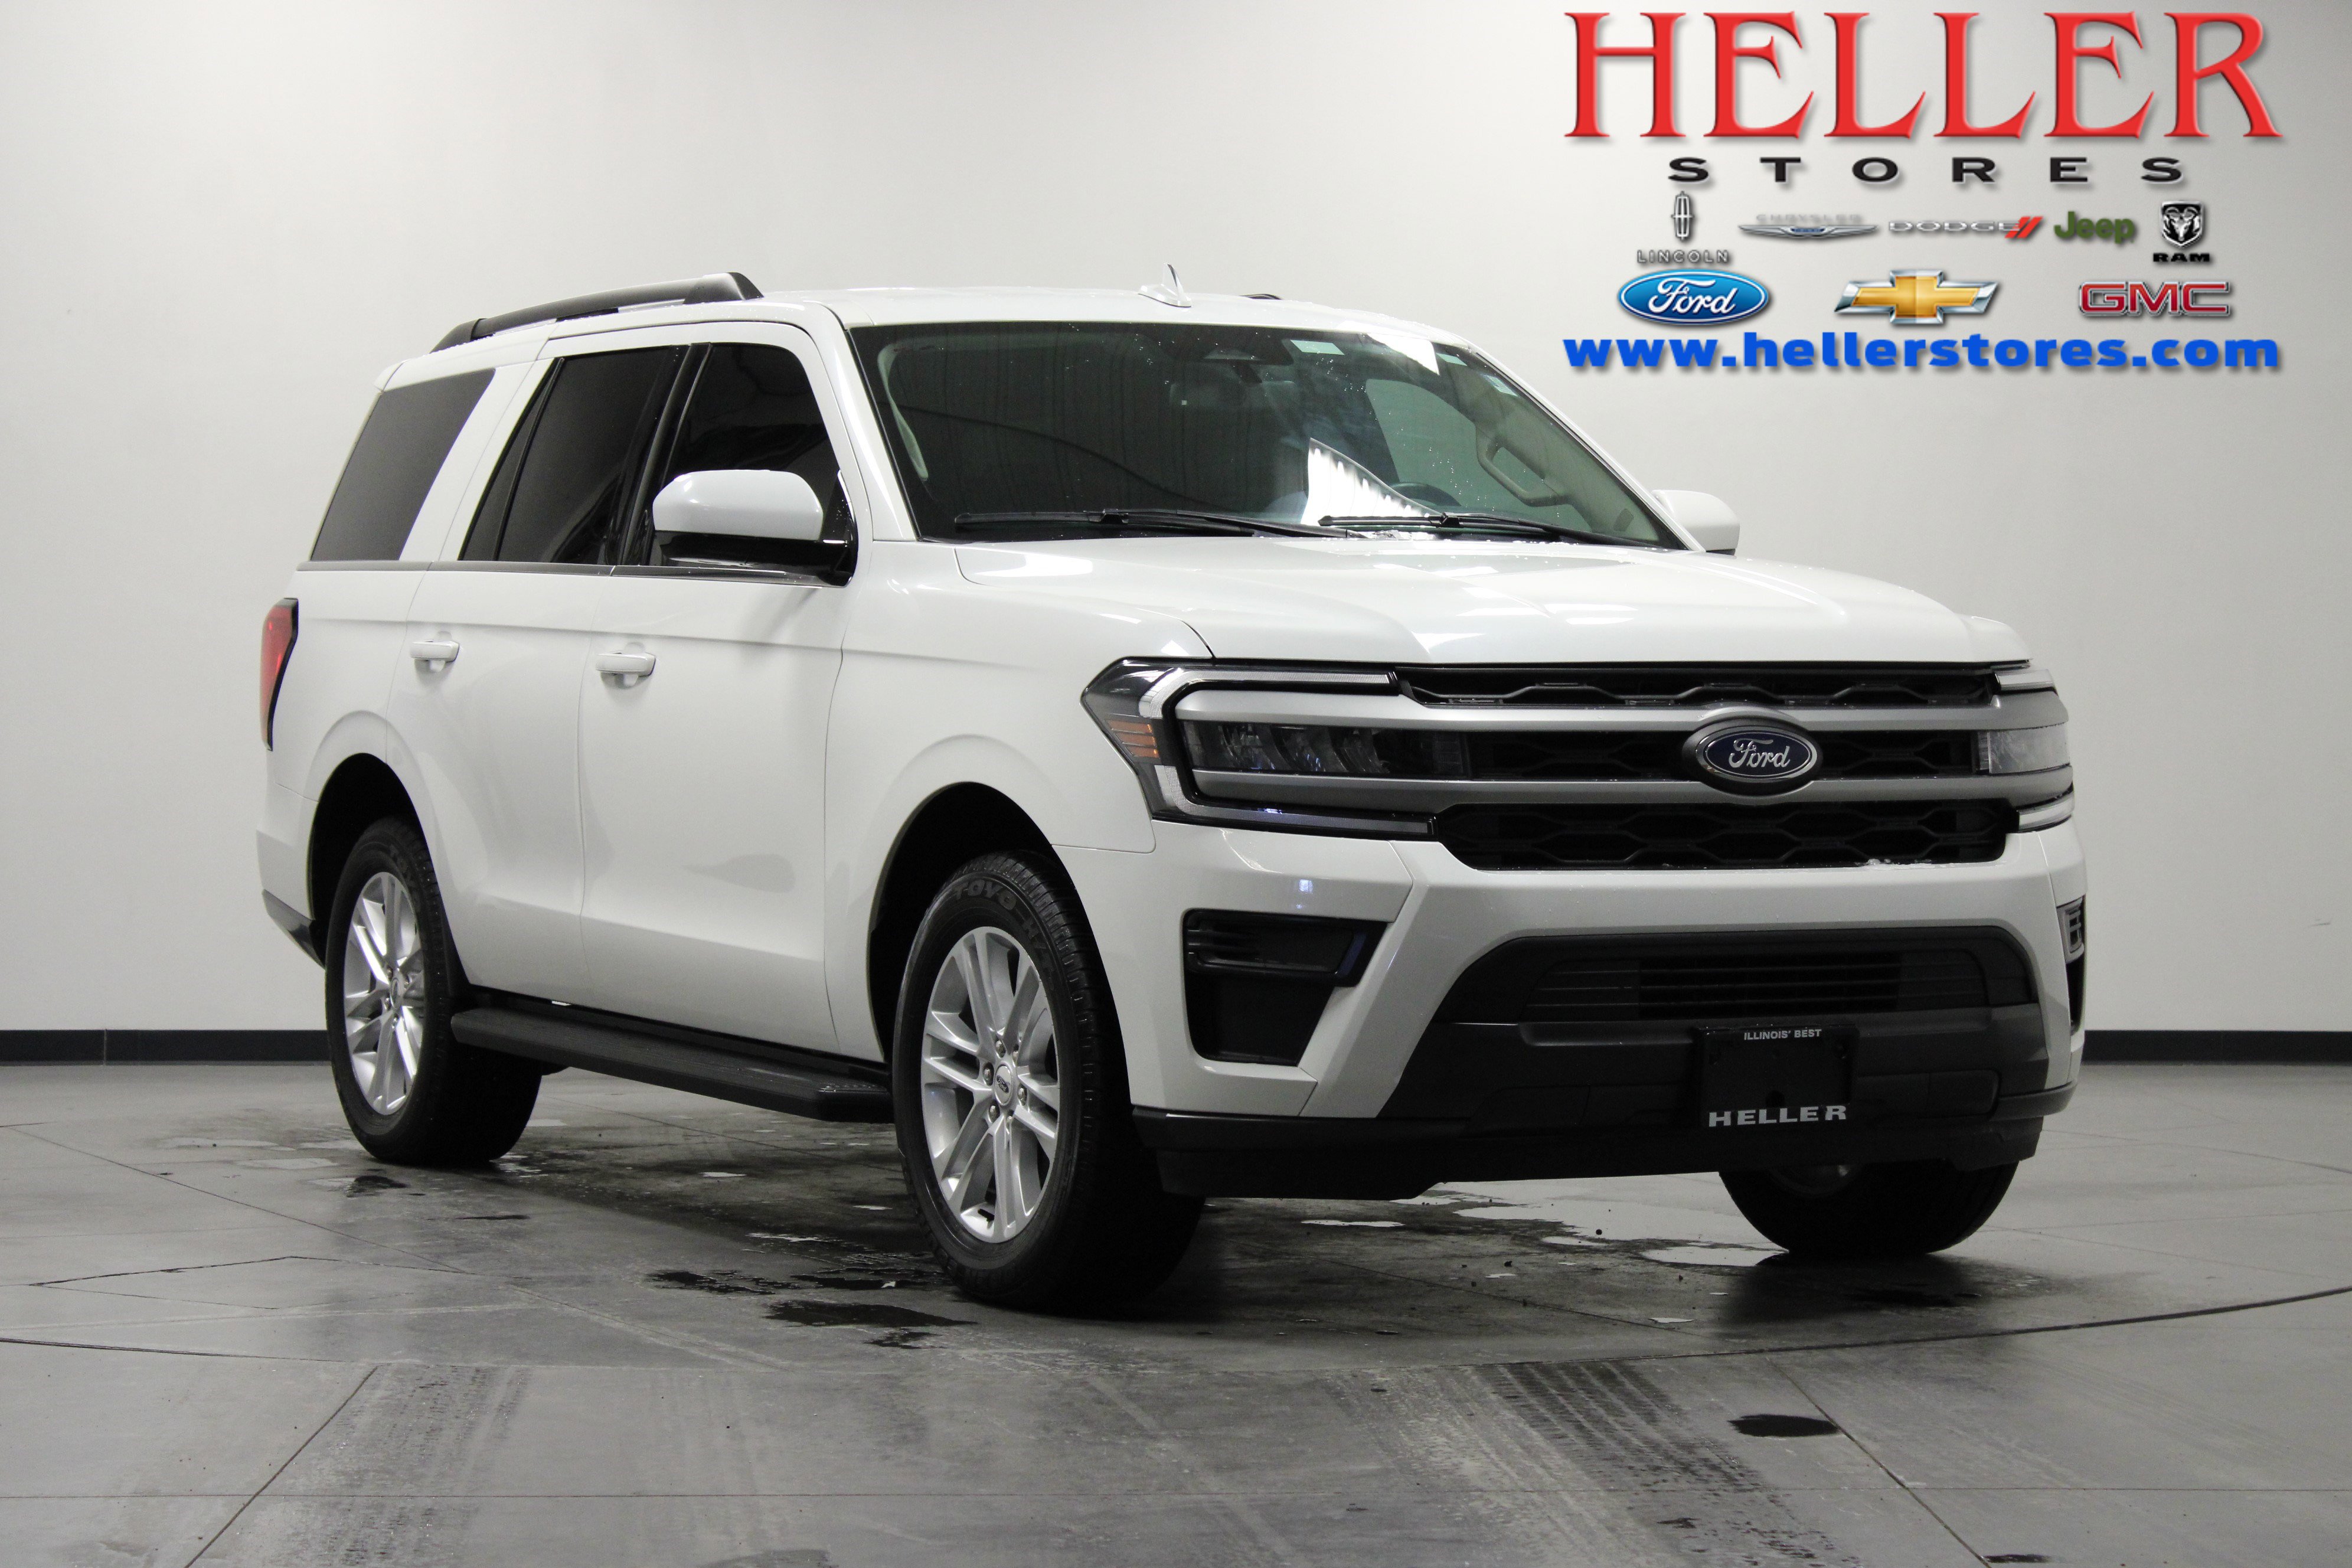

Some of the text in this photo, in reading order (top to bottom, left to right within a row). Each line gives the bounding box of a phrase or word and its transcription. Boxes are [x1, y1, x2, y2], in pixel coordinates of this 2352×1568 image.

[1728, 739, 1791, 768] Ford
[953, 878, 1017, 911] TOYO
[1794, 1029, 1822, 1038] BEST
[1709, 1105, 1847, 1128] HELLER
